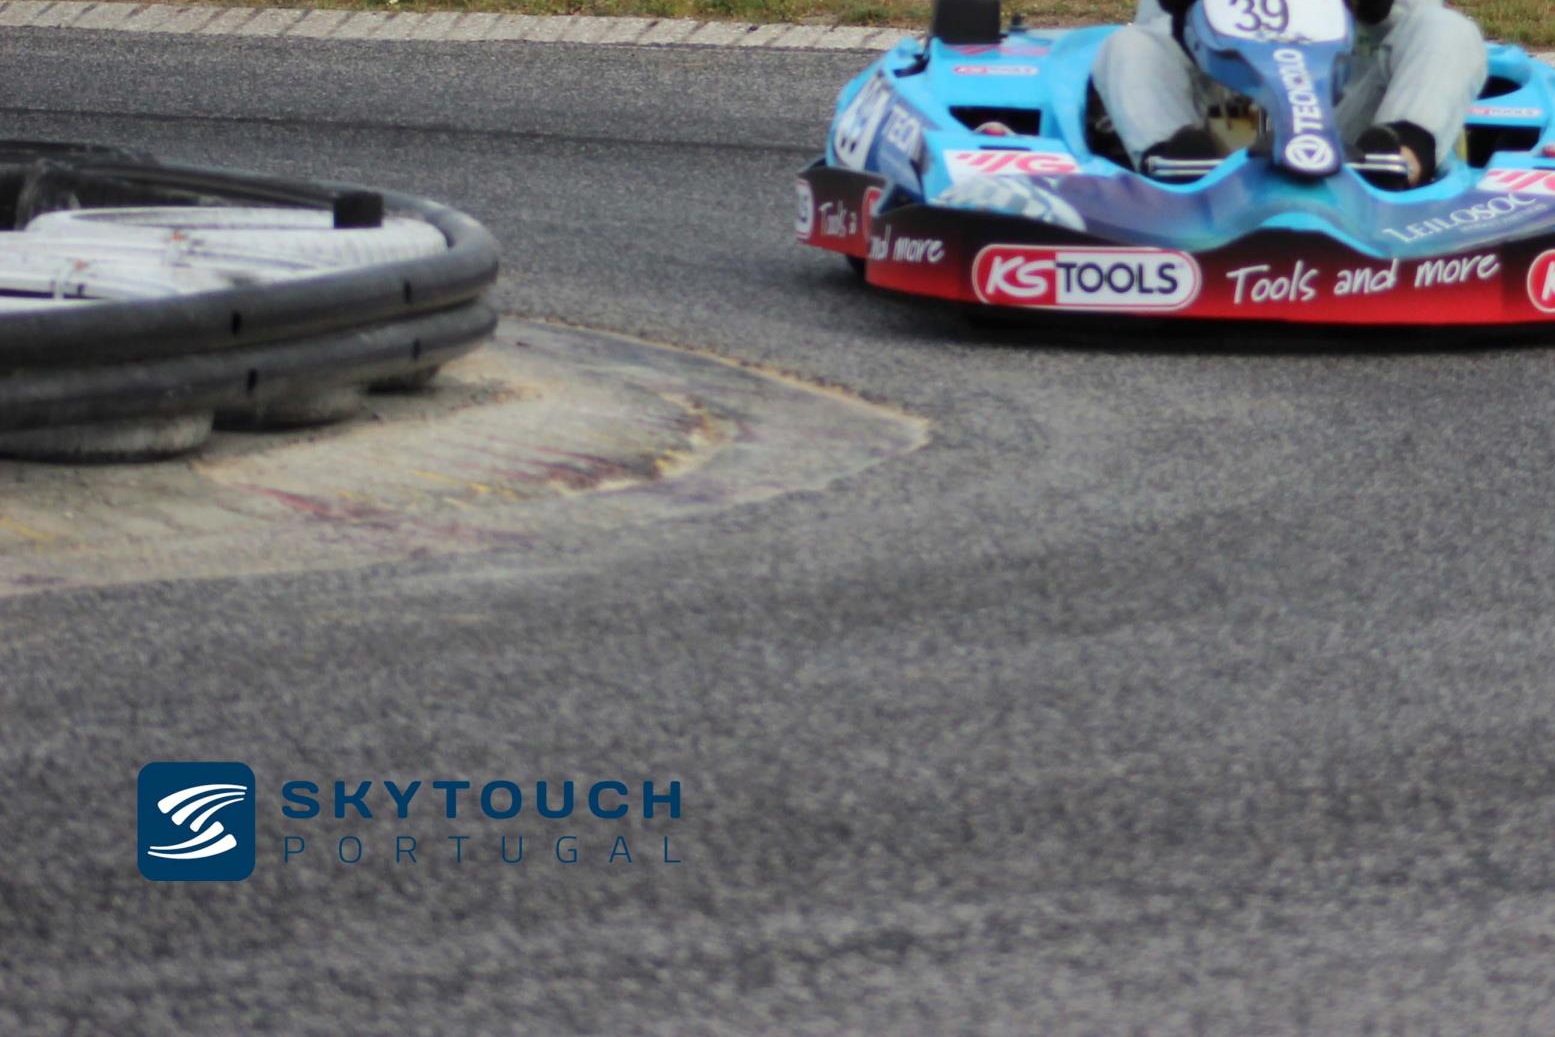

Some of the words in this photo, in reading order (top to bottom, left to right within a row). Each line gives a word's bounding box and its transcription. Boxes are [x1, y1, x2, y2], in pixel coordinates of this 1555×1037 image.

[893, 236, 945, 263] more
[986, 256, 1056, 300] KS
[1056, 262, 1179, 295] TOOLS
[1226, 261, 1319, 304] Tools
[1333, 258, 1397, 297] and
[1414, 253, 1500, 288] more
